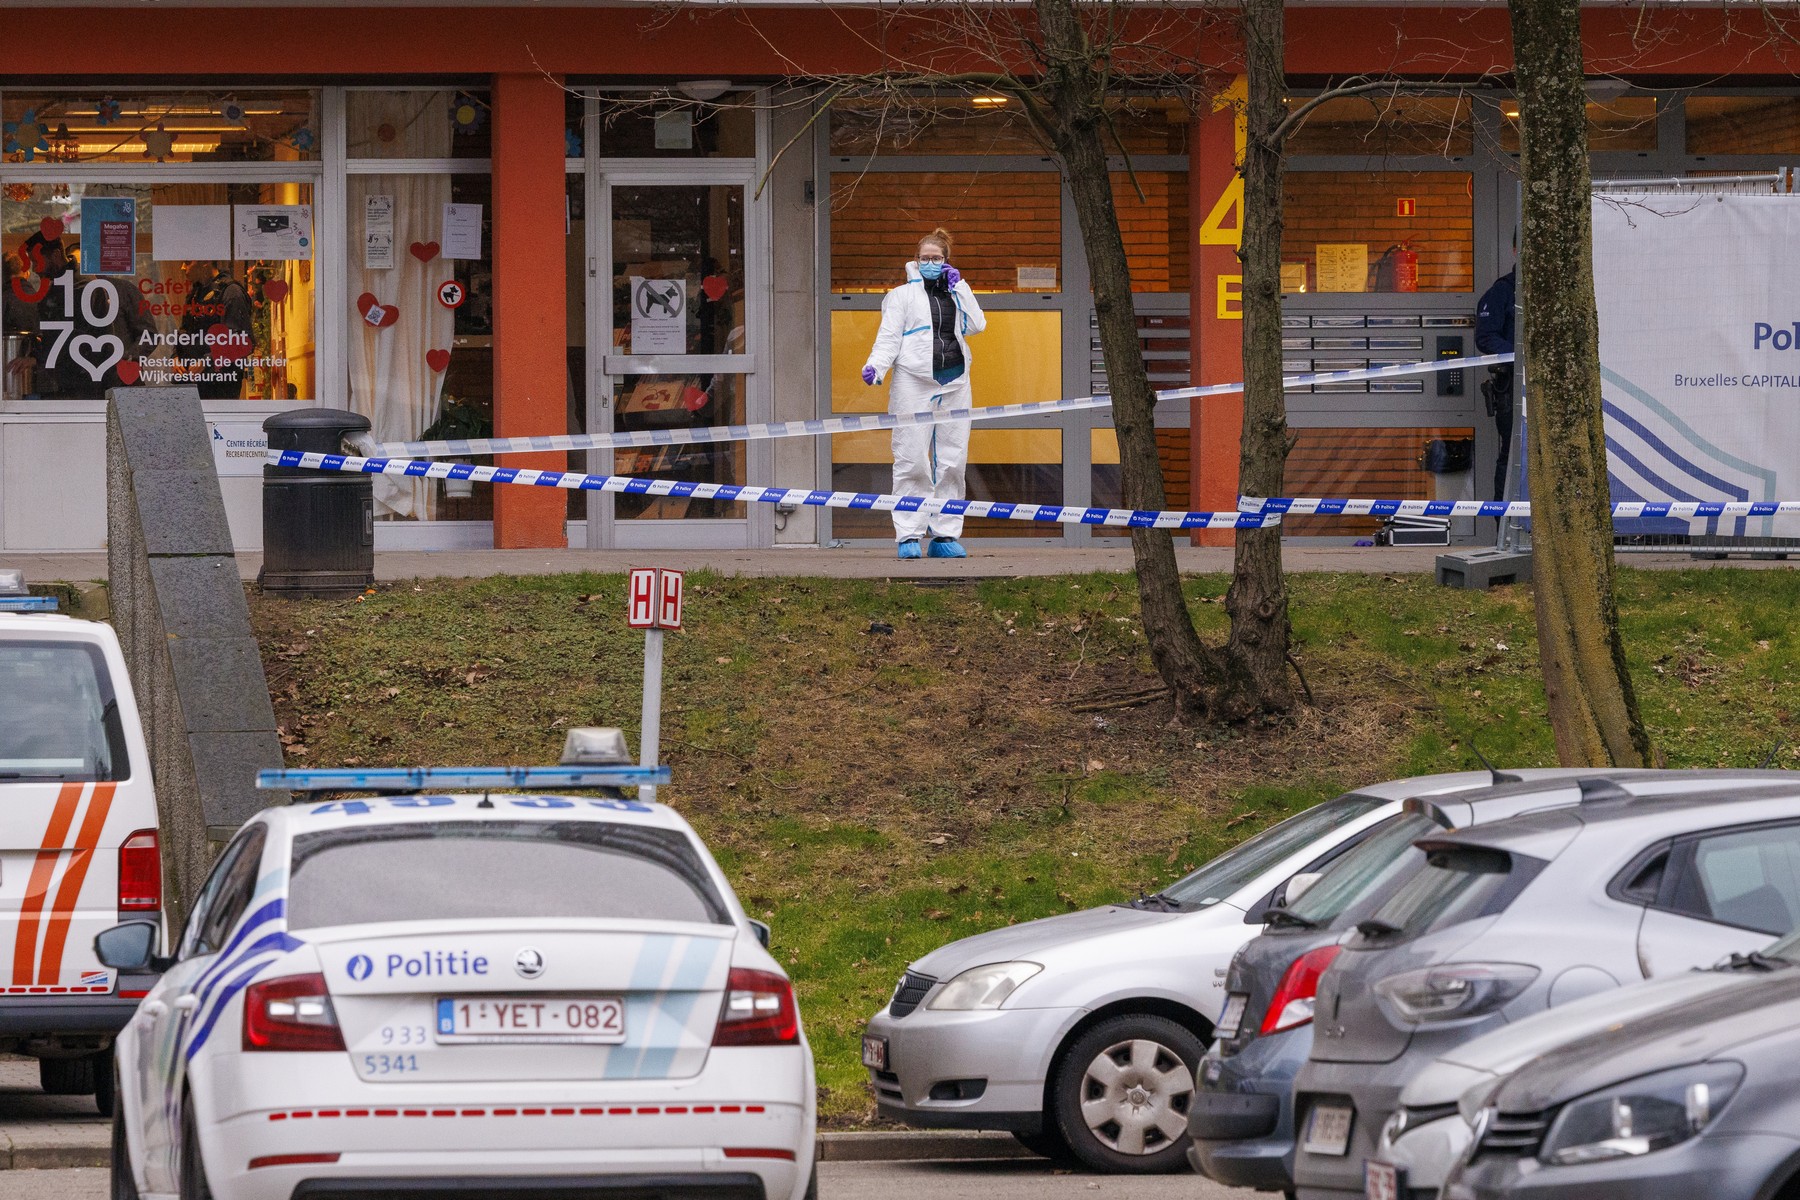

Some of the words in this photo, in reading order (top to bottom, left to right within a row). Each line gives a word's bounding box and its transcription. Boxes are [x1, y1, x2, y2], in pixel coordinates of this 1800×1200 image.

[53, 269, 119, 328] 10
[138, 300, 225, 317] Peterbos
[138, 329, 248, 346] Anderlecht
[1754, 322, 1800, 350] Pol
[138, 356, 212, 367] Restaurant
[214, 356, 231, 367] de
[234, 356, 288, 370] quartier
[138, 370, 238, 382] Wijkrestaurant
[1674, 373, 1738, 387] Bruxelles
[226, 440, 246, 448] CENTRE
[633, 576, 651, 619] H
[663, 576, 679, 621] H
[387, 951, 489, 978] Politie
[382, 1026, 427, 1045] 933
[365, 1054, 419, 1074] 5341
